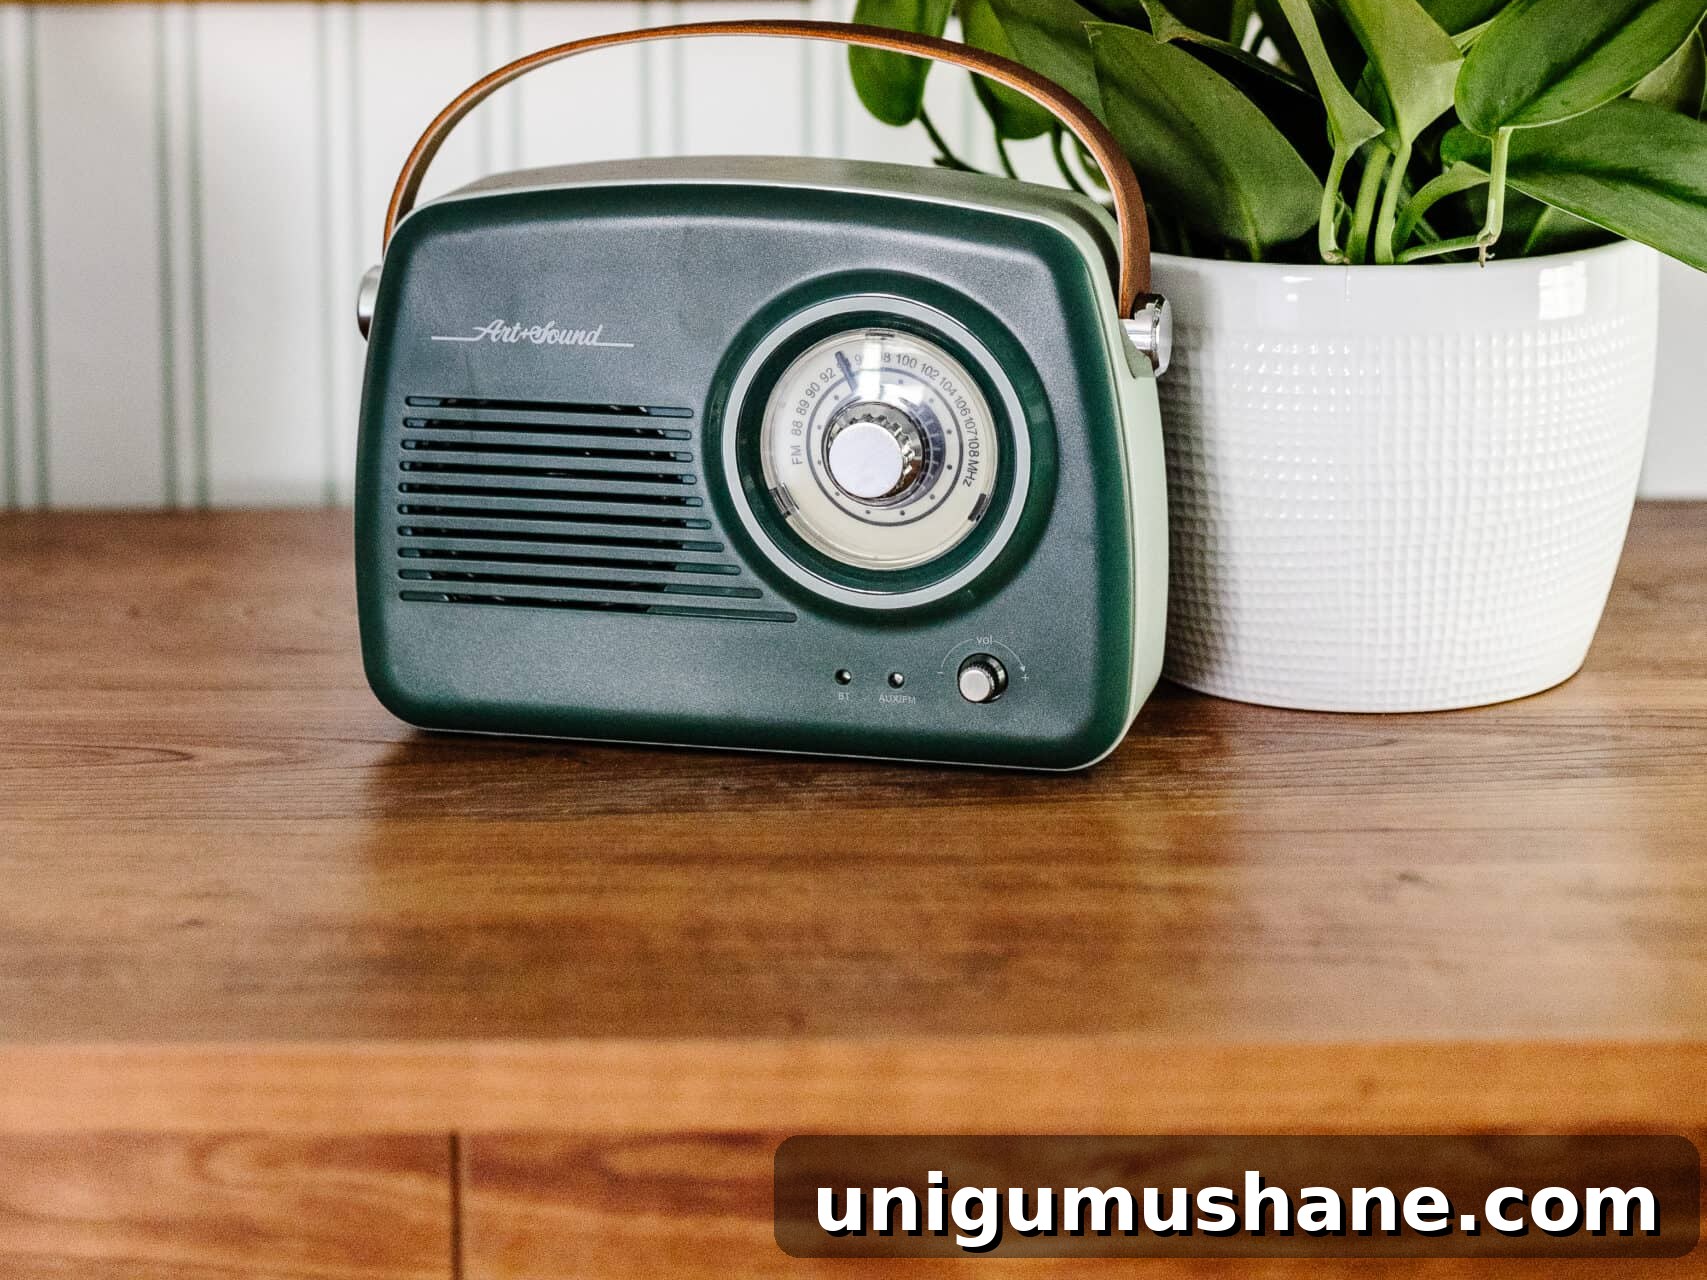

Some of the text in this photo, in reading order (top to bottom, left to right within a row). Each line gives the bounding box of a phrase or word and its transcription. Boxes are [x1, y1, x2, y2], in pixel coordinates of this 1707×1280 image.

[896, 353, 918, 368] 100
[819, 367, 836, 382] 92
[920, 363, 940, 380] 102
[805, 381, 820, 398] 90
[939, 377, 957, 396] 104
[796, 399, 810, 415] 89
[954, 396, 971, 417] 106
[792, 419, 803, 436] 88
[964, 417, 978, 436] 107
[791, 445, 802, 465] FM
[967, 438, 980, 458] 108
[962, 460, 980, 487] MHz
[976, 635, 993, 646] vol
